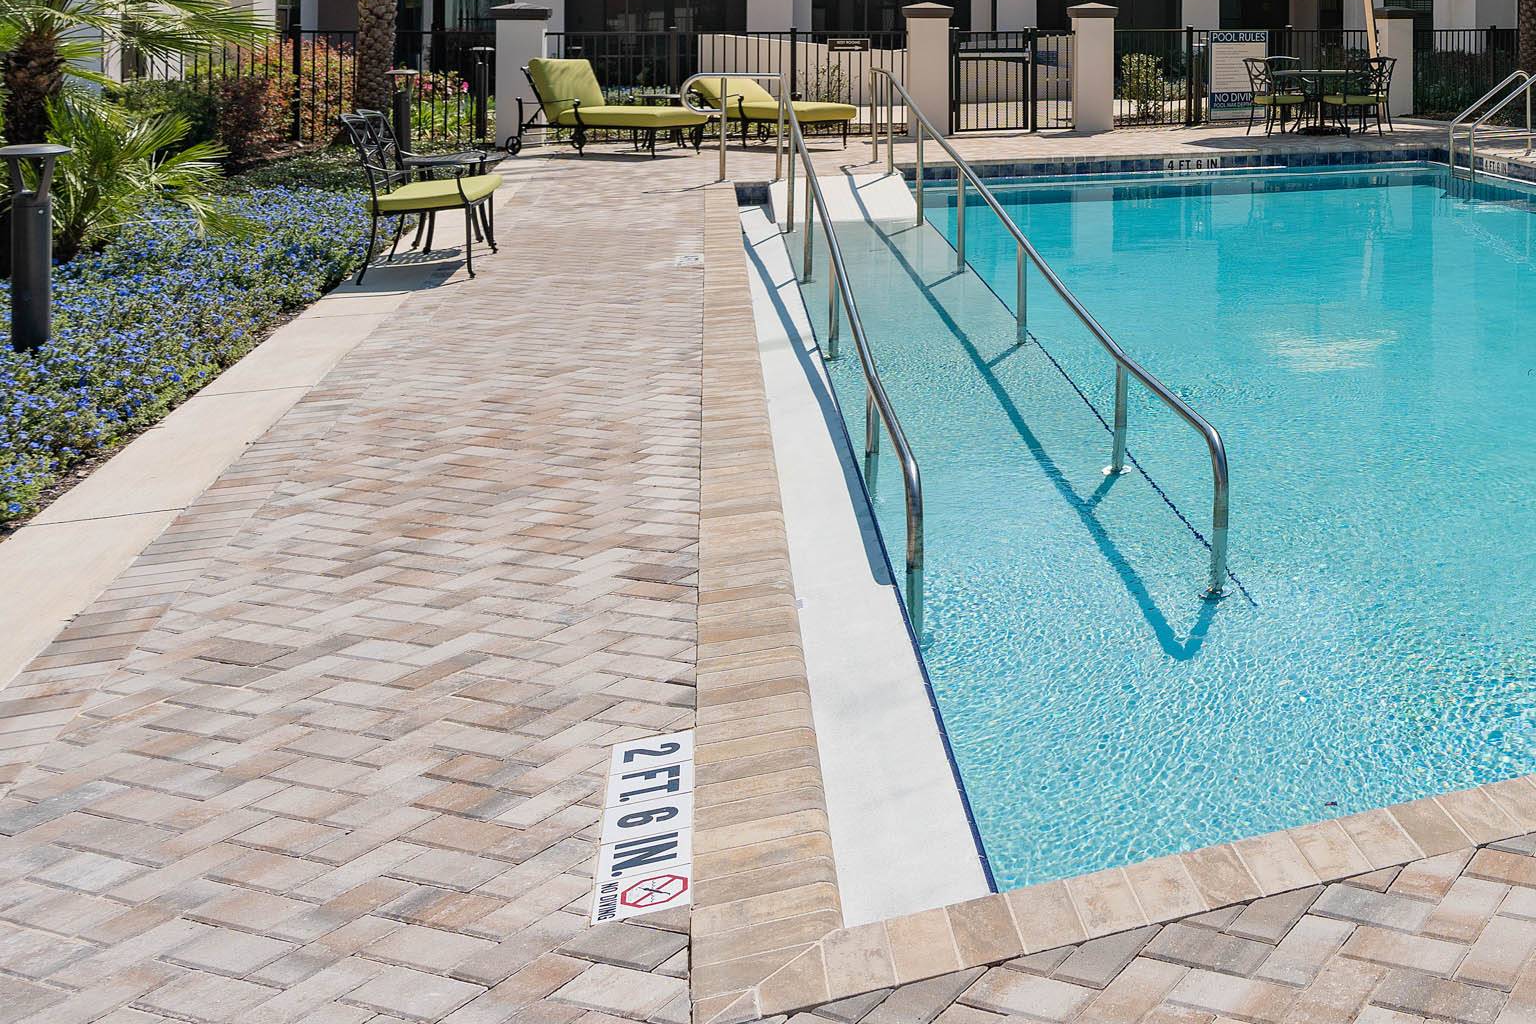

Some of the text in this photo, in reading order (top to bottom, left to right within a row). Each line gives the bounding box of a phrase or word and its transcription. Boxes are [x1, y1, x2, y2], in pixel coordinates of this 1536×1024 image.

[1212, 32, 1266, 42] POOL RULES
[1214, 92, 1254, 102] NO DIVIN
[1167, 159, 1174, 170] 4
[1196, 159, 1202, 169] 6
[610, 742, 681, 878] 2 FT. 6 IN.
[597, 881, 619, 921] NO DIVING
